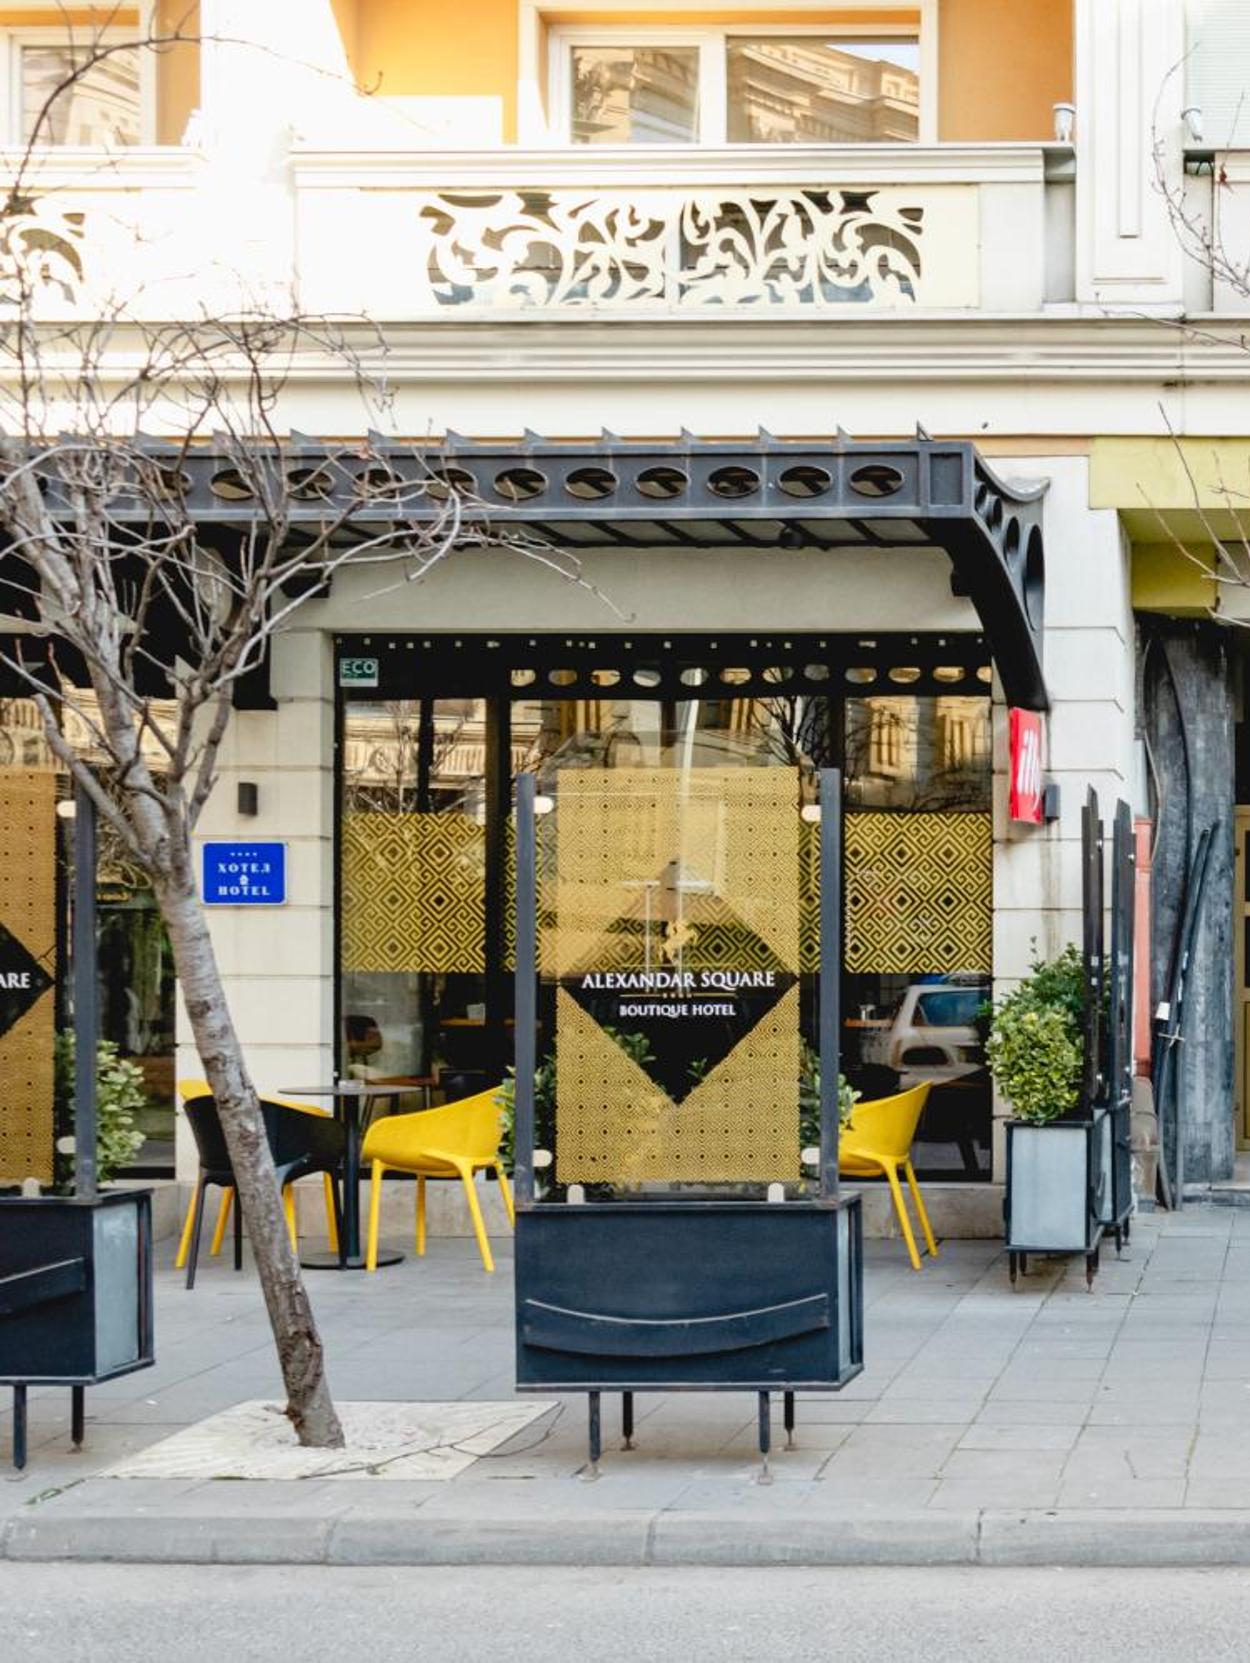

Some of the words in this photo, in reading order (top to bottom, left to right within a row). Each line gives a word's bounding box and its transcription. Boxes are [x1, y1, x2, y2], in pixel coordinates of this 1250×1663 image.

[341, 660, 377, 674] ECO
[218, 885, 271, 896] HOTEL
[581, 972, 696, 989] ALEXANDAR
[700, 970, 776, 991] SQUARE
[619, 1004, 689, 1018] BOUTIQUE
[692, 1004, 737, 1016] HOTEL
